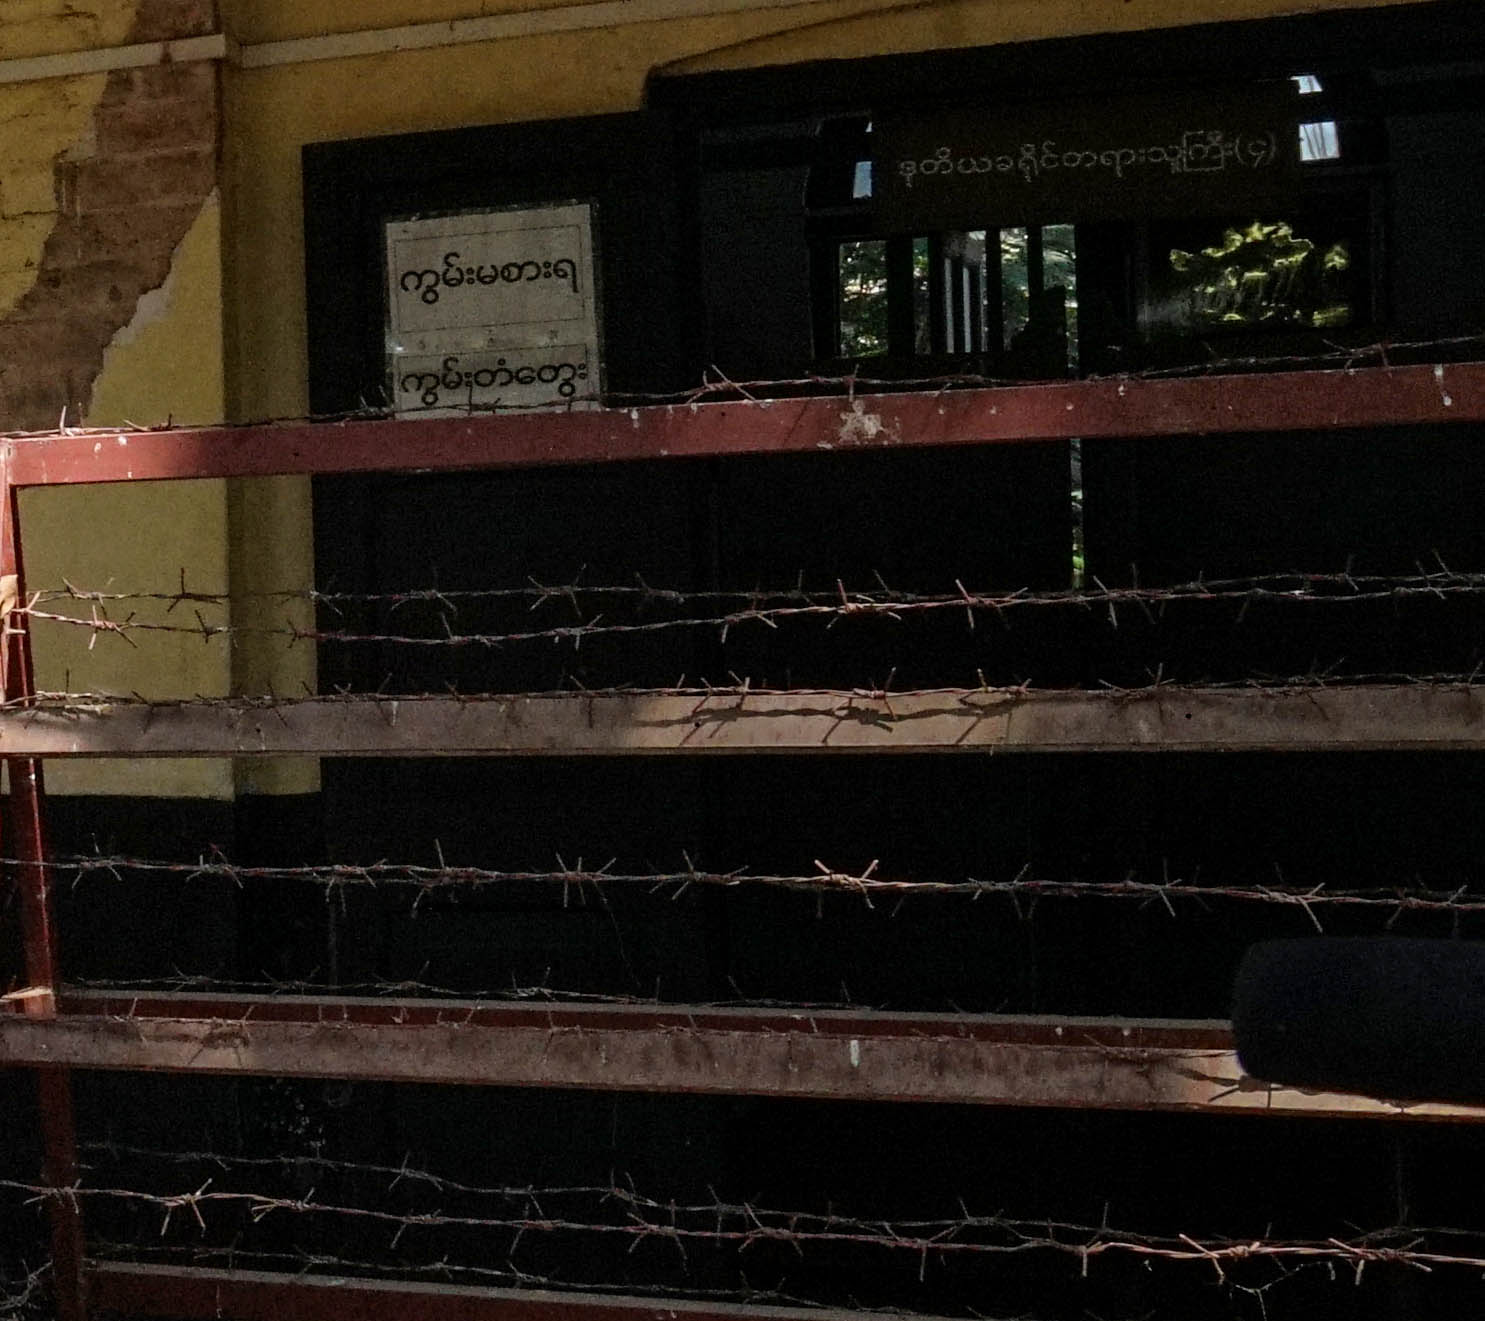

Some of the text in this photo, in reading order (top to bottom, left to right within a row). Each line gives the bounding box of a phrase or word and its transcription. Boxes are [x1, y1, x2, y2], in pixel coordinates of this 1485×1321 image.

[399, 251, 580, 305] ကွမ်းမစားရ
[400, 356, 588, 406] ကွမ်းတံတွေး
